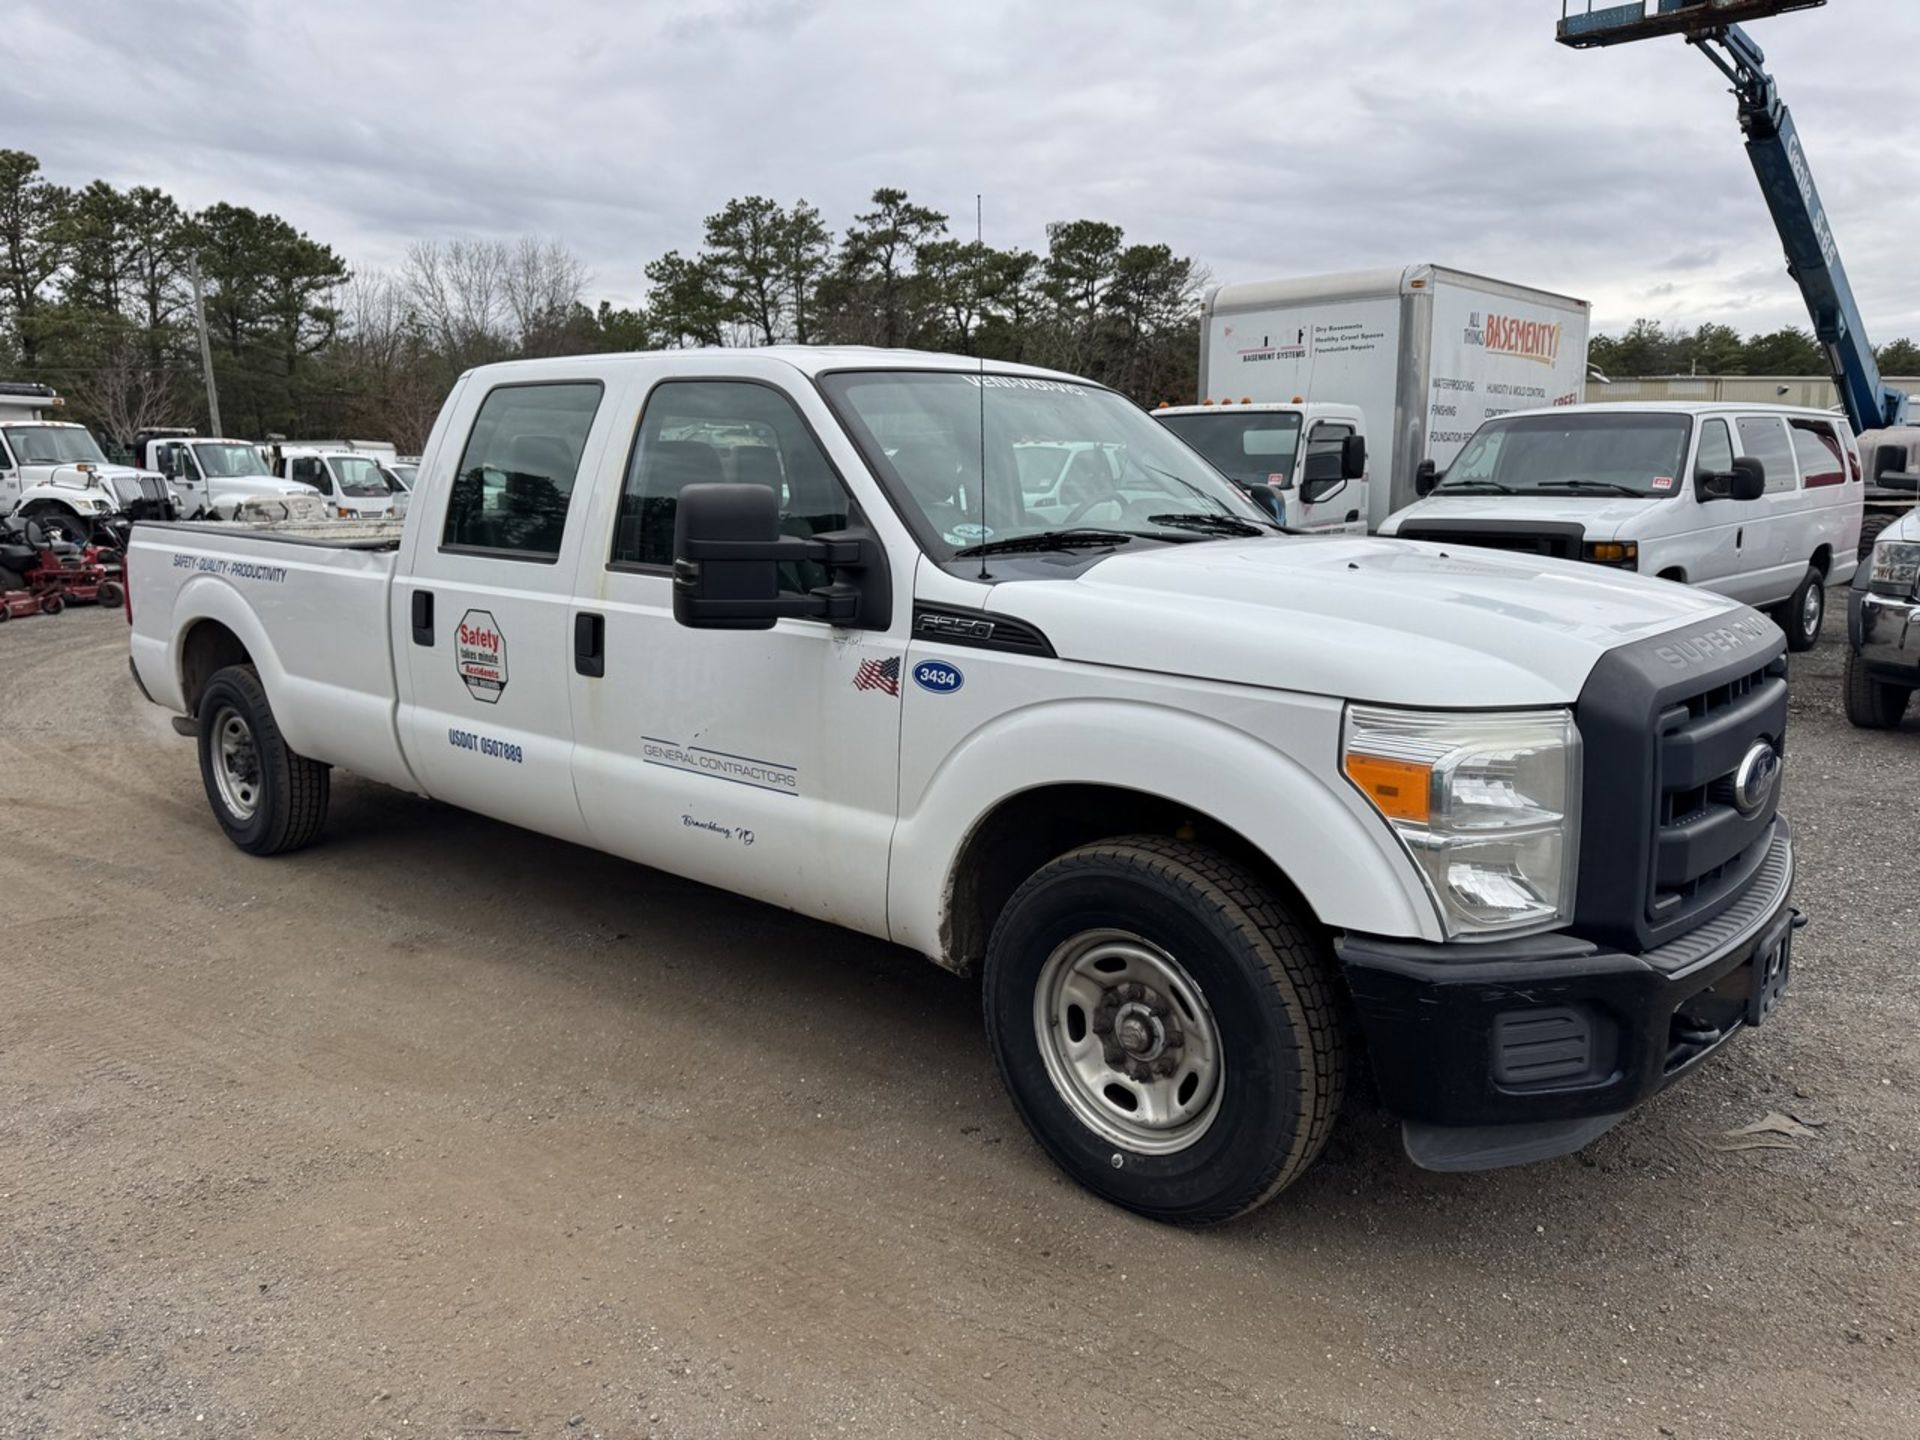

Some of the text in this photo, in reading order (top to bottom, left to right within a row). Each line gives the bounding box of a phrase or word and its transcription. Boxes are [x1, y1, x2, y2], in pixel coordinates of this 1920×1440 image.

[1469, 312, 1480, 328] ALL
[1243, 350, 1305, 363] BASEMENT SYSTEMS
[173, 554, 287, 583] SAFETY QUALITY PRODUCTIVITY
[460, 623, 499, 653] Safety
[1655, 627, 1743, 670] SUPER
[465, 665, 499, 679] Accidents
[920, 668, 955, 686] 3434
[449, 728, 523, 763] USDOT 0507889
[644, 744, 797, 787] GENERAL CONTRACTORS
